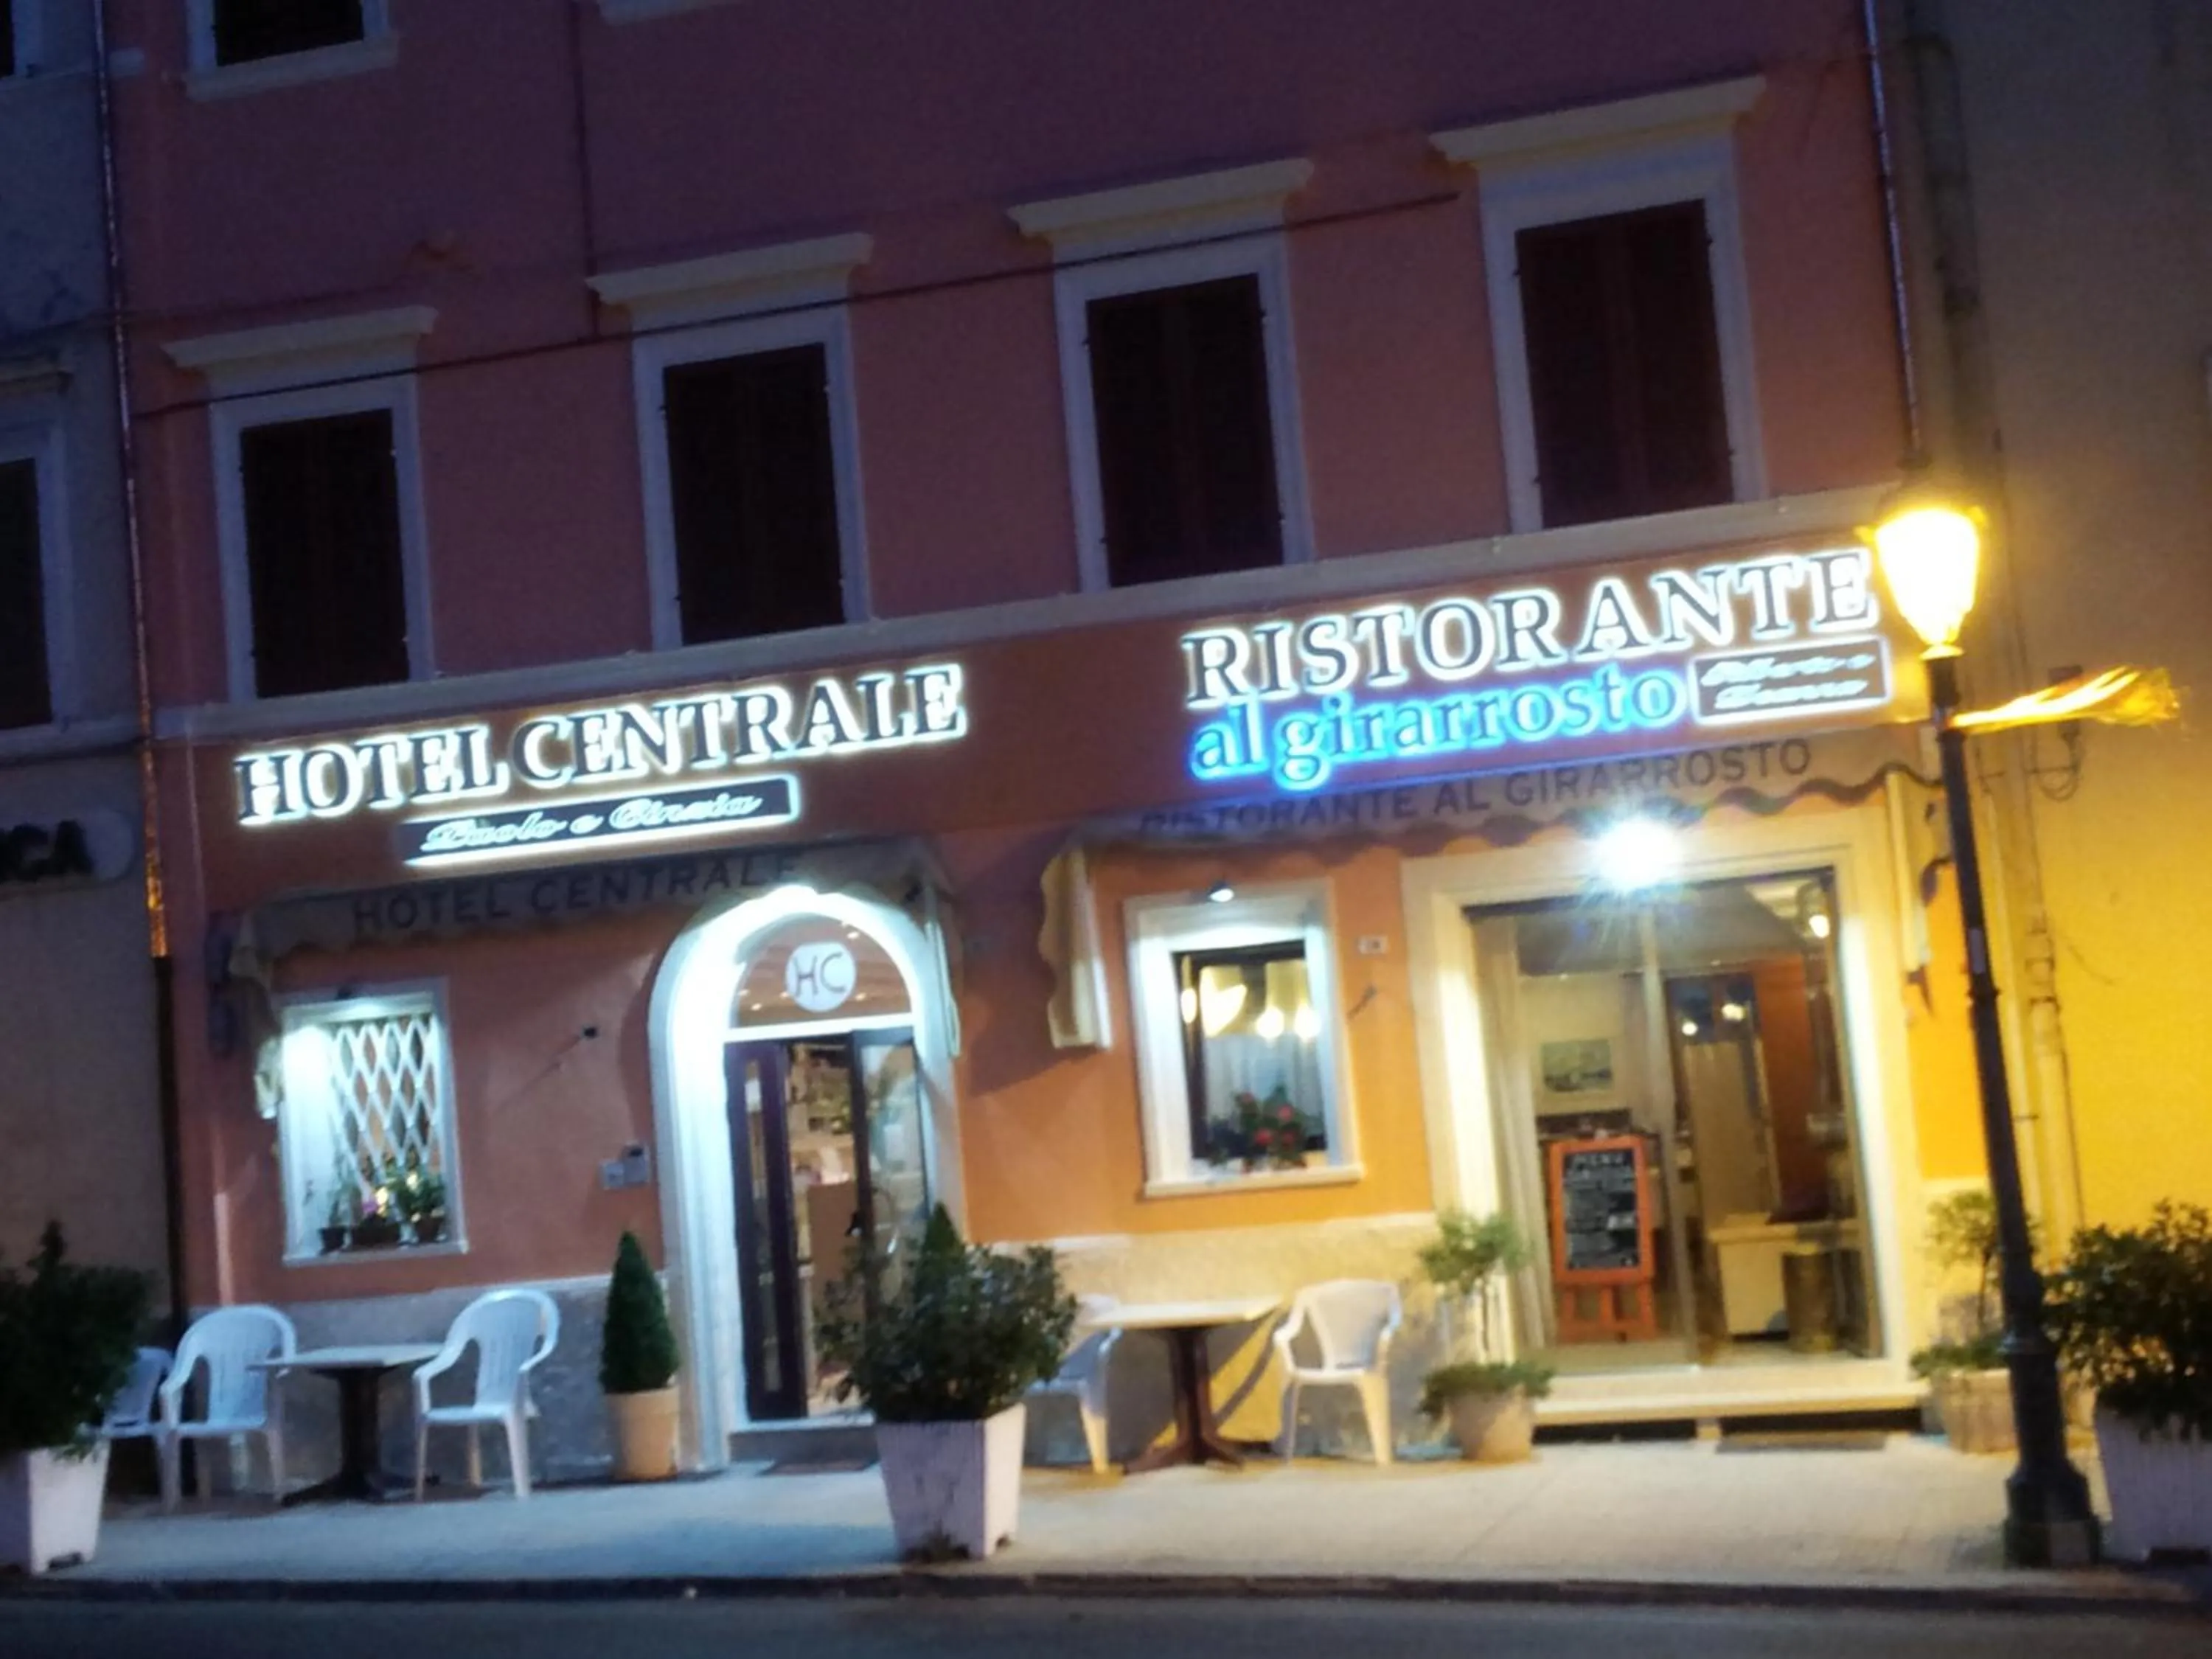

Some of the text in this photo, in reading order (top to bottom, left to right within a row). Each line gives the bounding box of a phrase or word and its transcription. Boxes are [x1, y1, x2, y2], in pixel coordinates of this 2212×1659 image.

[1181, 549, 1879, 709] RISTORANTE
[234, 665, 967, 827] HOTEL CENTRALE
[1190, 664, 1688, 793] al girarrosto
[1433, 782, 1491, 817] AL
[1503, 736, 1812, 808] GIRARROSTO
[352, 852, 799, 933] HOTEL CENTRALE
[792, 950, 848, 1000] HC
